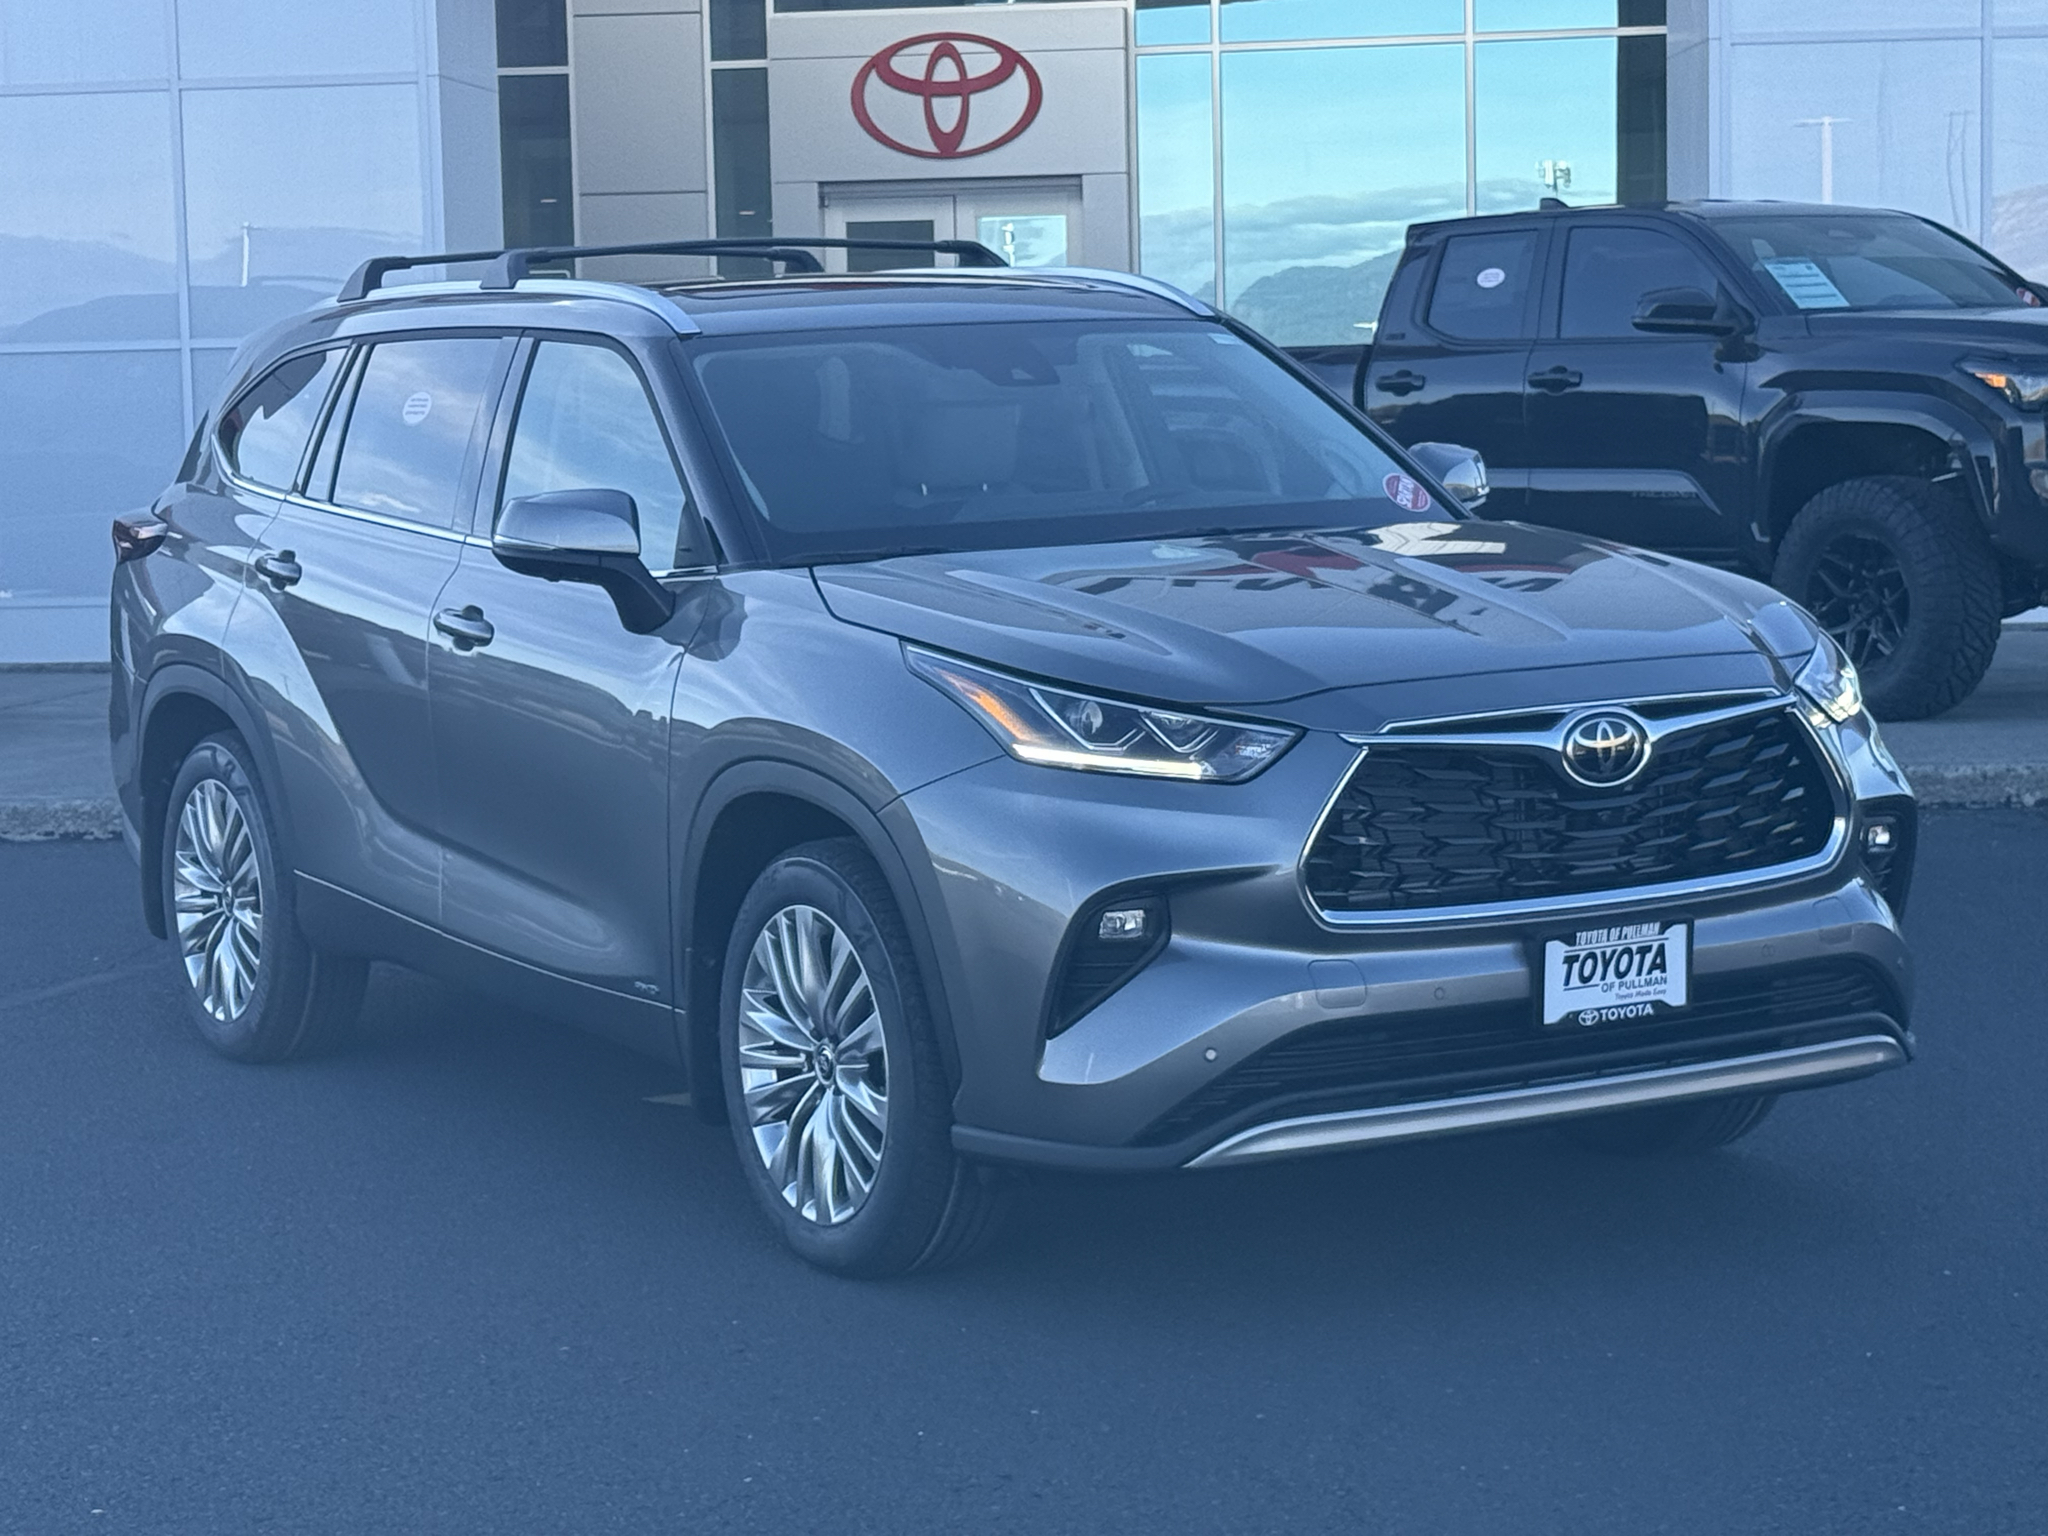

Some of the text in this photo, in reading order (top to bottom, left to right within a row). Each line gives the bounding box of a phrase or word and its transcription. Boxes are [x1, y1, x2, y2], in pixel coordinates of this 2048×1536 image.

[1576, 921, 1661, 946] TOYOTA OF PULLMAN
[1562, 943, 1667, 987] TOYOTA
[1601, 975, 1668, 993] OF PULLMAN
[1600, 1003, 1654, 1022] TOYOTA
